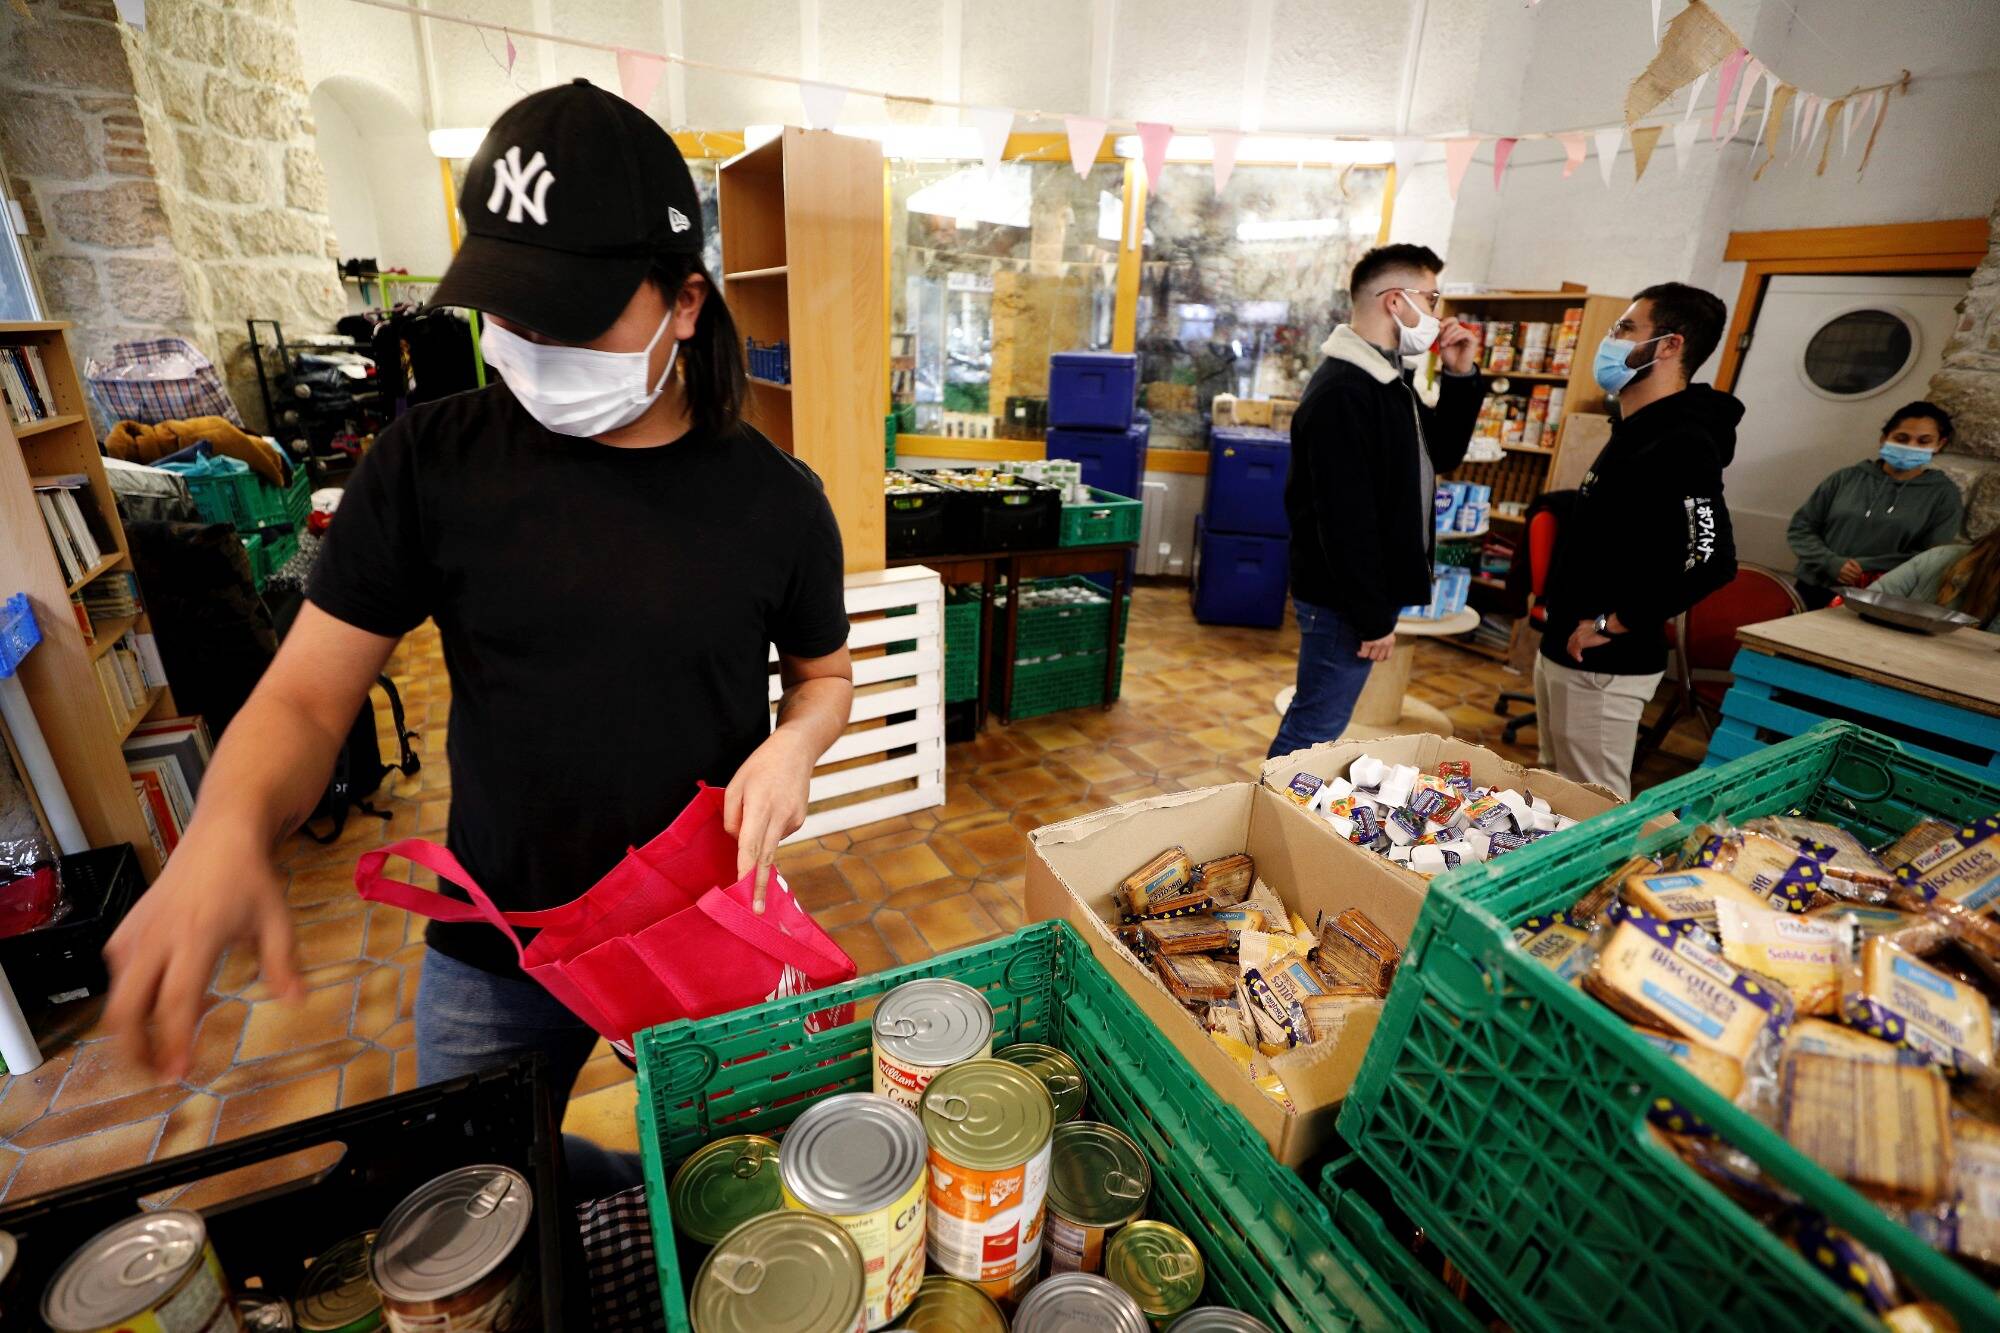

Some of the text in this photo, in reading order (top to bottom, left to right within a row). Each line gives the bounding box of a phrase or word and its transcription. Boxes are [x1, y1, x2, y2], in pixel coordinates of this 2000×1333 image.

[487, 146, 556, 226] NY
[1281, 971, 1298, 994] Pocket
[1651, 946, 1738, 1015] Biscottes
[1265, 994, 1285, 1020] Pasquier
[879, 1059, 916, 1088] William
